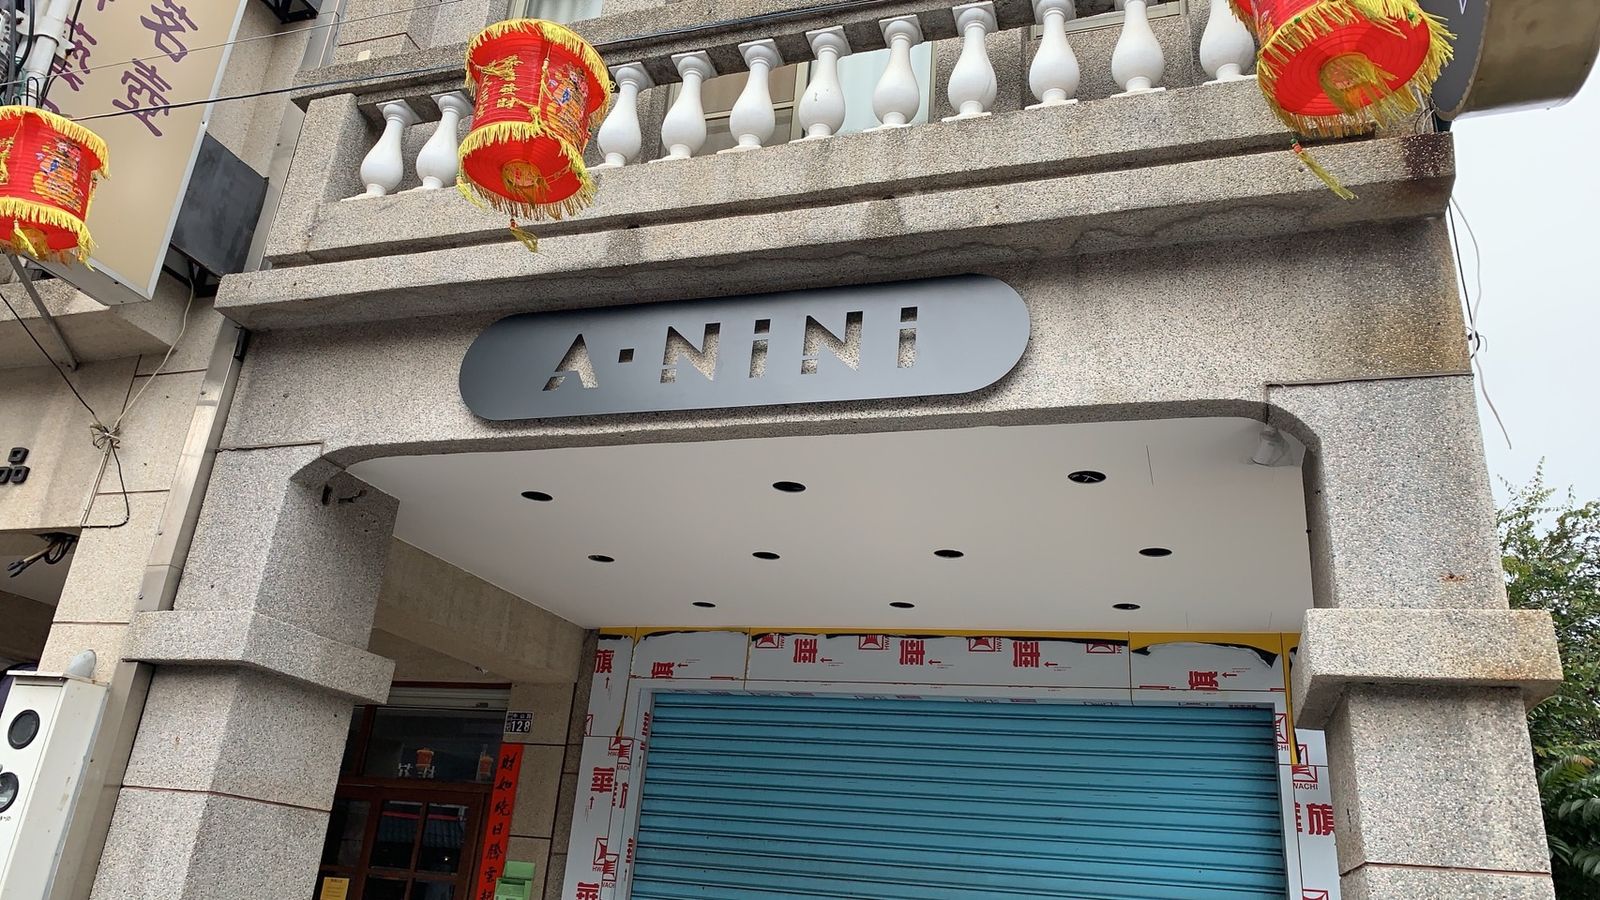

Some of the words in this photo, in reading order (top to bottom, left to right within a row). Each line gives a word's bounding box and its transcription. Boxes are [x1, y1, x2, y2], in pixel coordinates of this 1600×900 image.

[112, 0, 198, 137] 名產
[511, 720, 531, 732] 128
[1295, 802, 1335, 836] 旗
